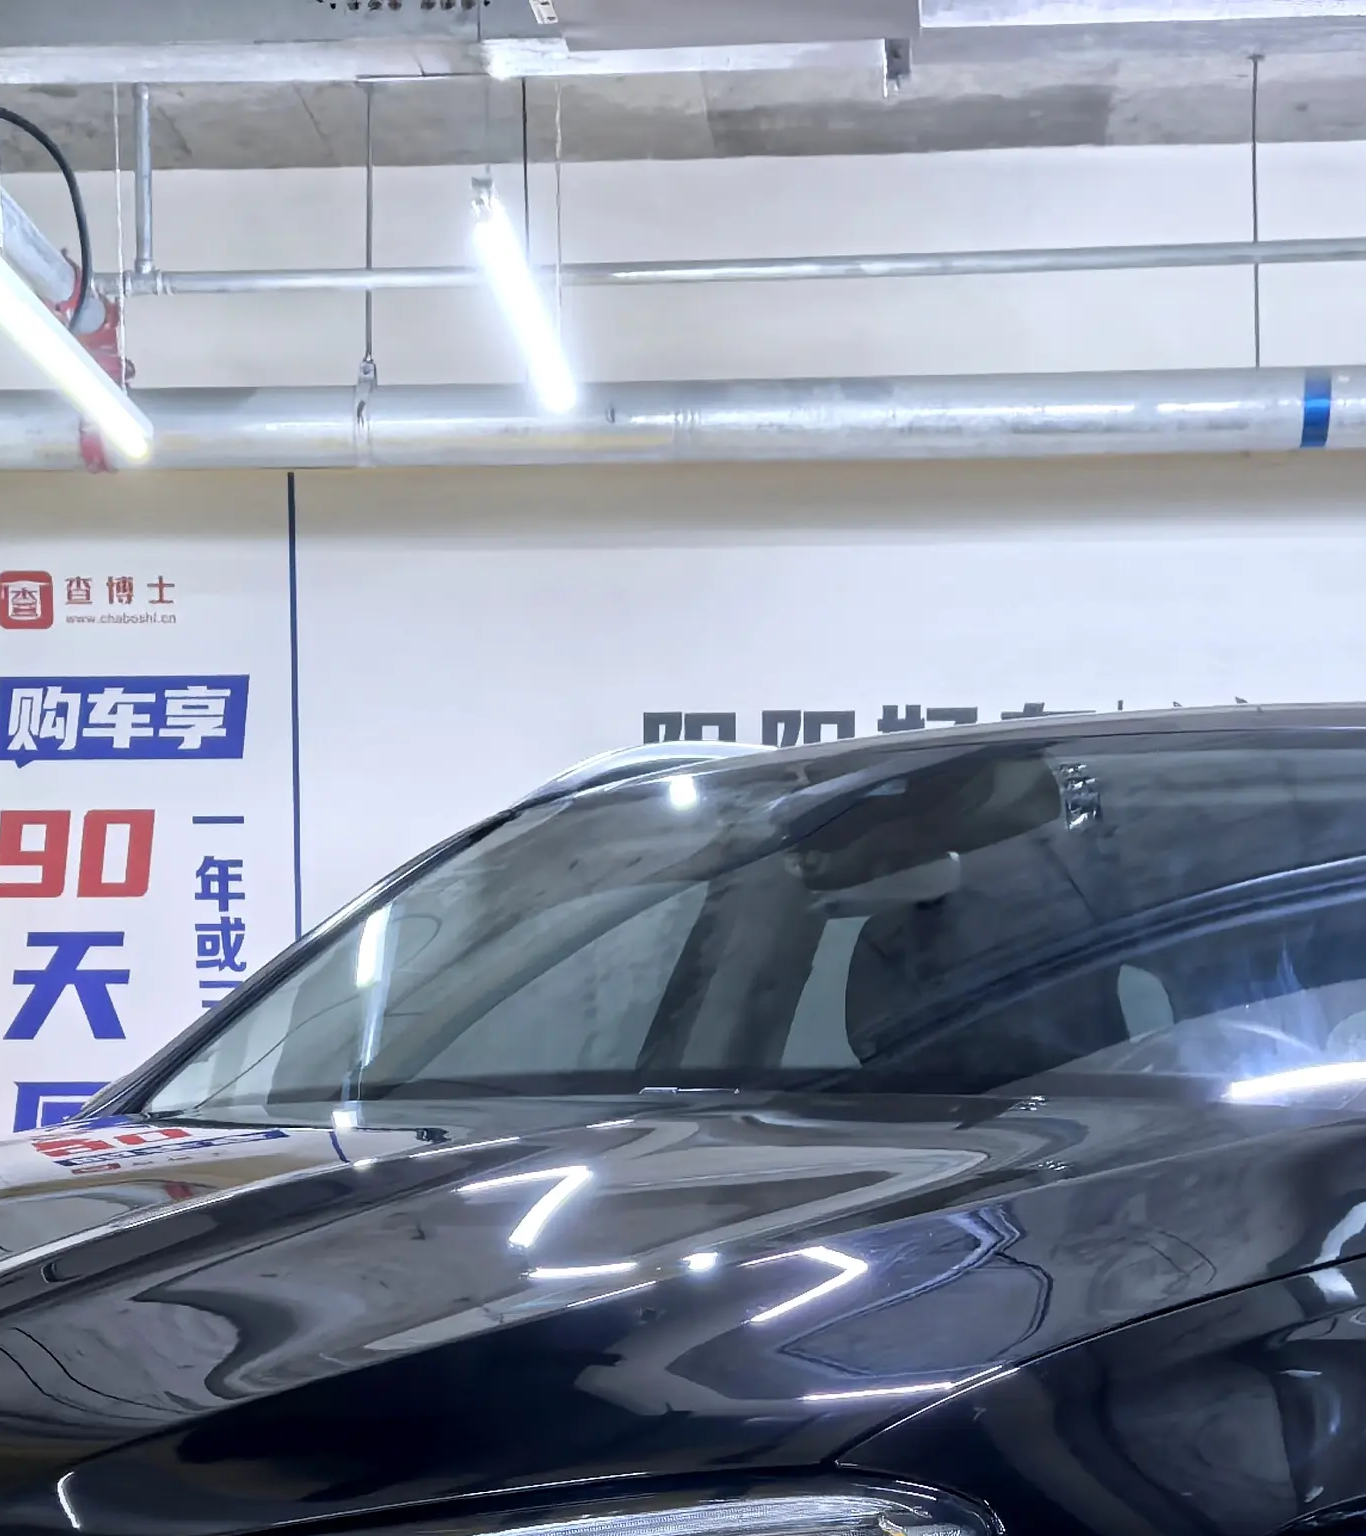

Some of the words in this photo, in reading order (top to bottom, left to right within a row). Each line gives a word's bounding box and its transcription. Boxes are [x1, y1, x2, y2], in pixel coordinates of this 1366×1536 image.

[65, 575, 176, 605] 查博士
[6, 685, 232, 752] 购车享
